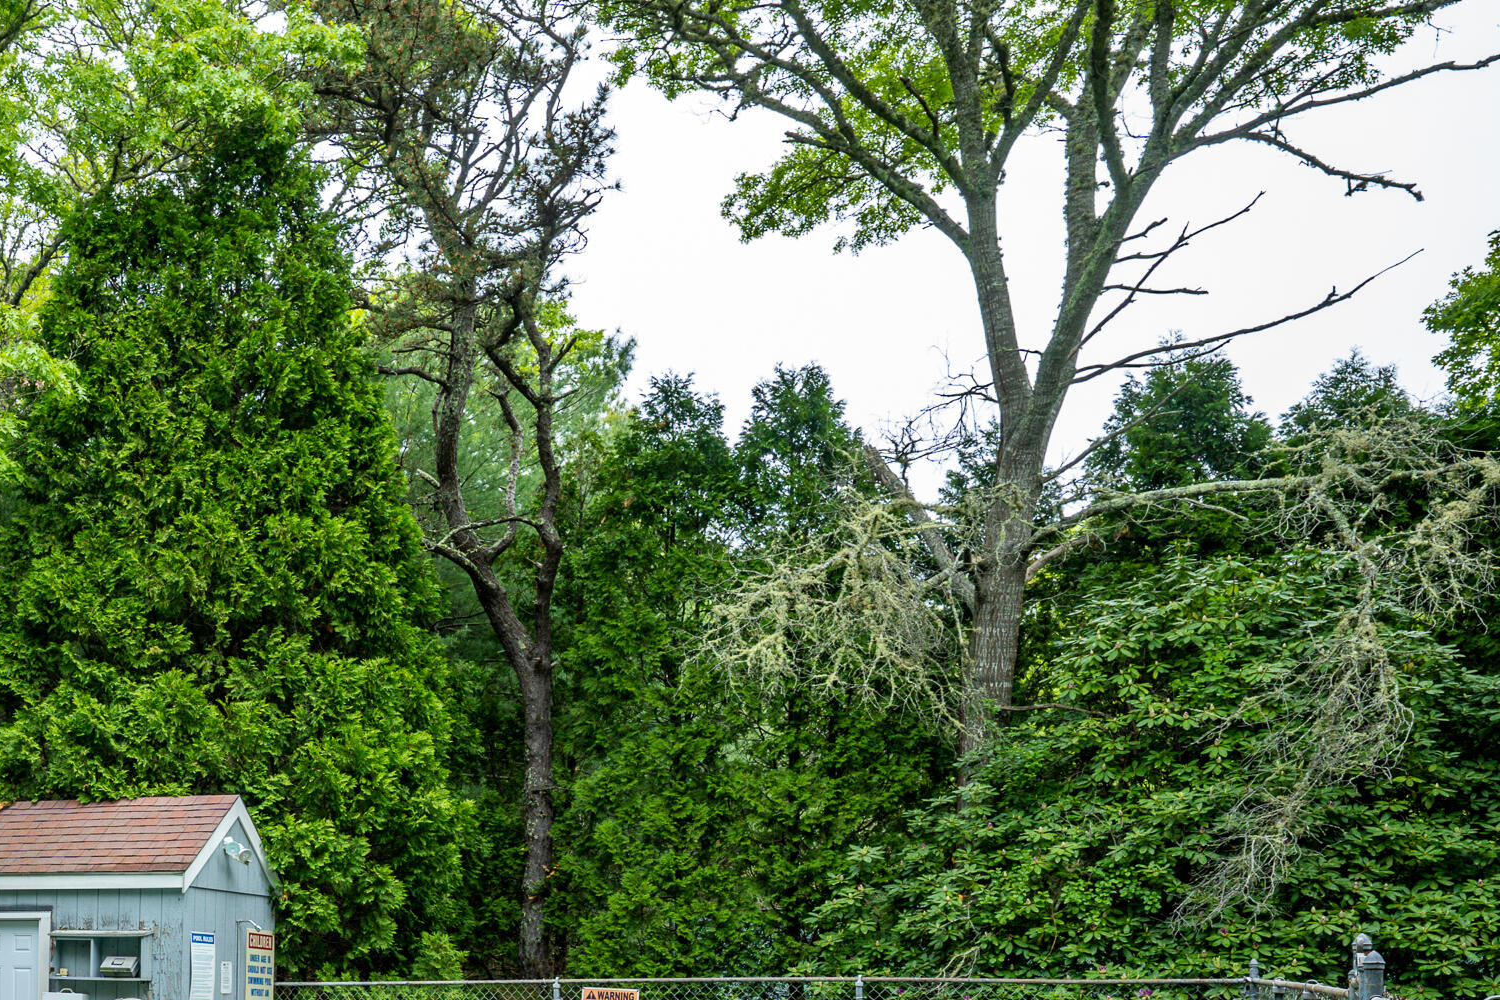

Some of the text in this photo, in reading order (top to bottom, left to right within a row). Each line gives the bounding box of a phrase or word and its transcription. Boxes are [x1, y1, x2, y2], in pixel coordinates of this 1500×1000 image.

[250, 934, 271, 949] CHILDREN
[248, 976, 263, 985] SWIMMING
[251, 988, 264, 997] WITHOUT
